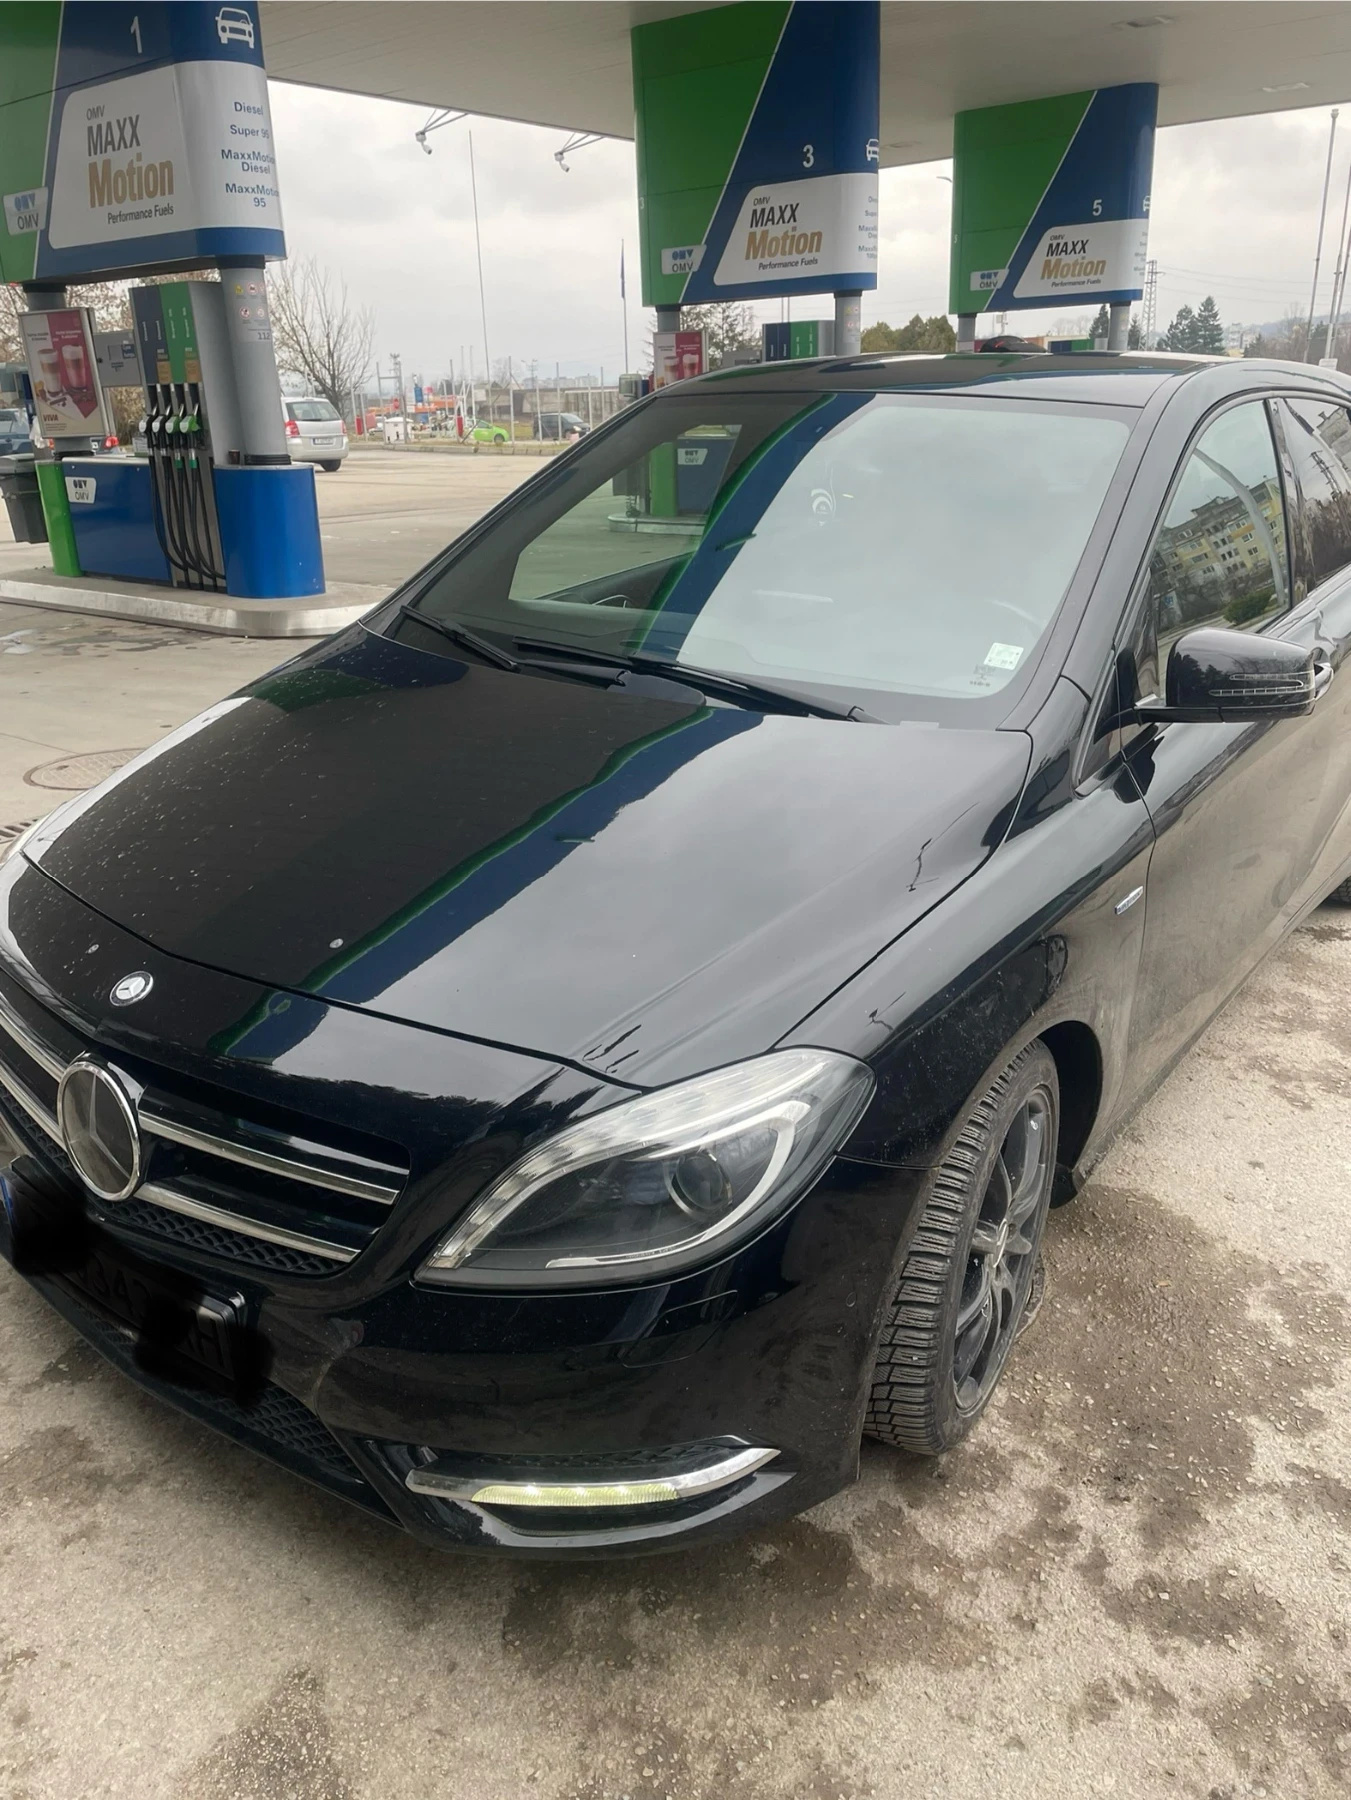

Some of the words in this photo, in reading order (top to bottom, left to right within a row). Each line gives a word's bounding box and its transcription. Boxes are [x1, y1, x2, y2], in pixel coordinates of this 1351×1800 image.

[130, 15, 143, 54] 1
[86, 105, 106, 121] OMV
[233, 101, 264, 116] Diesel
[86, 114, 141, 157] MAXX
[229, 124, 260, 138] Super
[260, 128, 270, 139] 95
[802, 144, 815, 168] 3
[241, 161, 271, 175] Diesel
[88, 152, 174, 209] Motion
[253, 197, 267, 208] 95
[753, 196, 771, 206] OMV
[1092, 199, 1103, 217] 5
[107, 207, 153, 225] Performance
[153, 202, 175, 218] Fuels
[750, 202, 800, 229] MAXX
[17, 213, 40, 231] OMV
[745, 227, 823, 261] Motion
[1050, 234, 1065, 242] OMV
[1046, 239, 1090, 258] MAXX
[671, 262, 694, 273] OMV
[758, 259, 800, 271] Performance
[800, 256, 819, 267] Fuels
[1040, 255, 1107, 281] Motion
[979, 281, 998, 289] OMV
[1051, 279, 1086, 288] Performance
[1086, 278, 1102, 286] Fuels
[42, 413, 59, 423] VIVA
[74, 491, 90, 501] OMV
